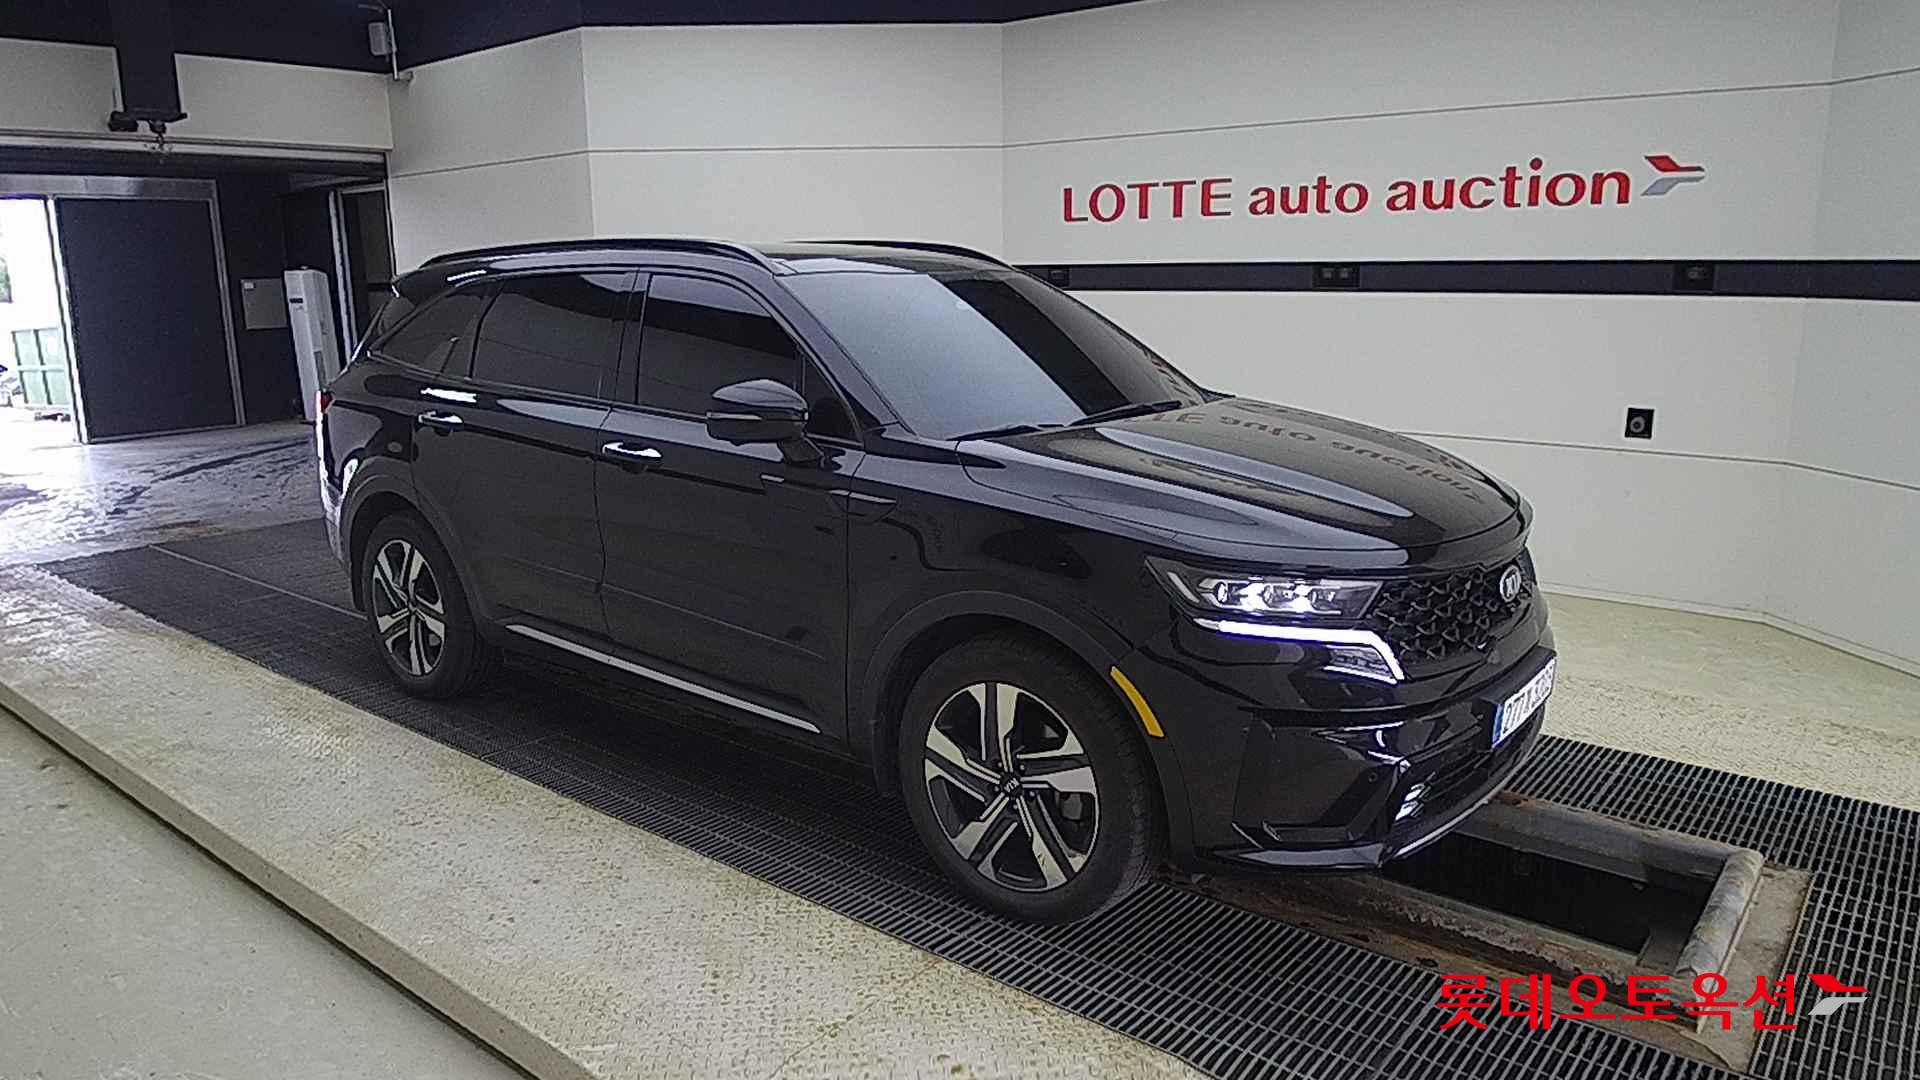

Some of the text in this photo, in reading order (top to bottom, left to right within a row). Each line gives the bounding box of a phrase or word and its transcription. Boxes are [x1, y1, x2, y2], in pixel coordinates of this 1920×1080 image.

[1063, 157, 1632, 223] LOTTE auto auction
